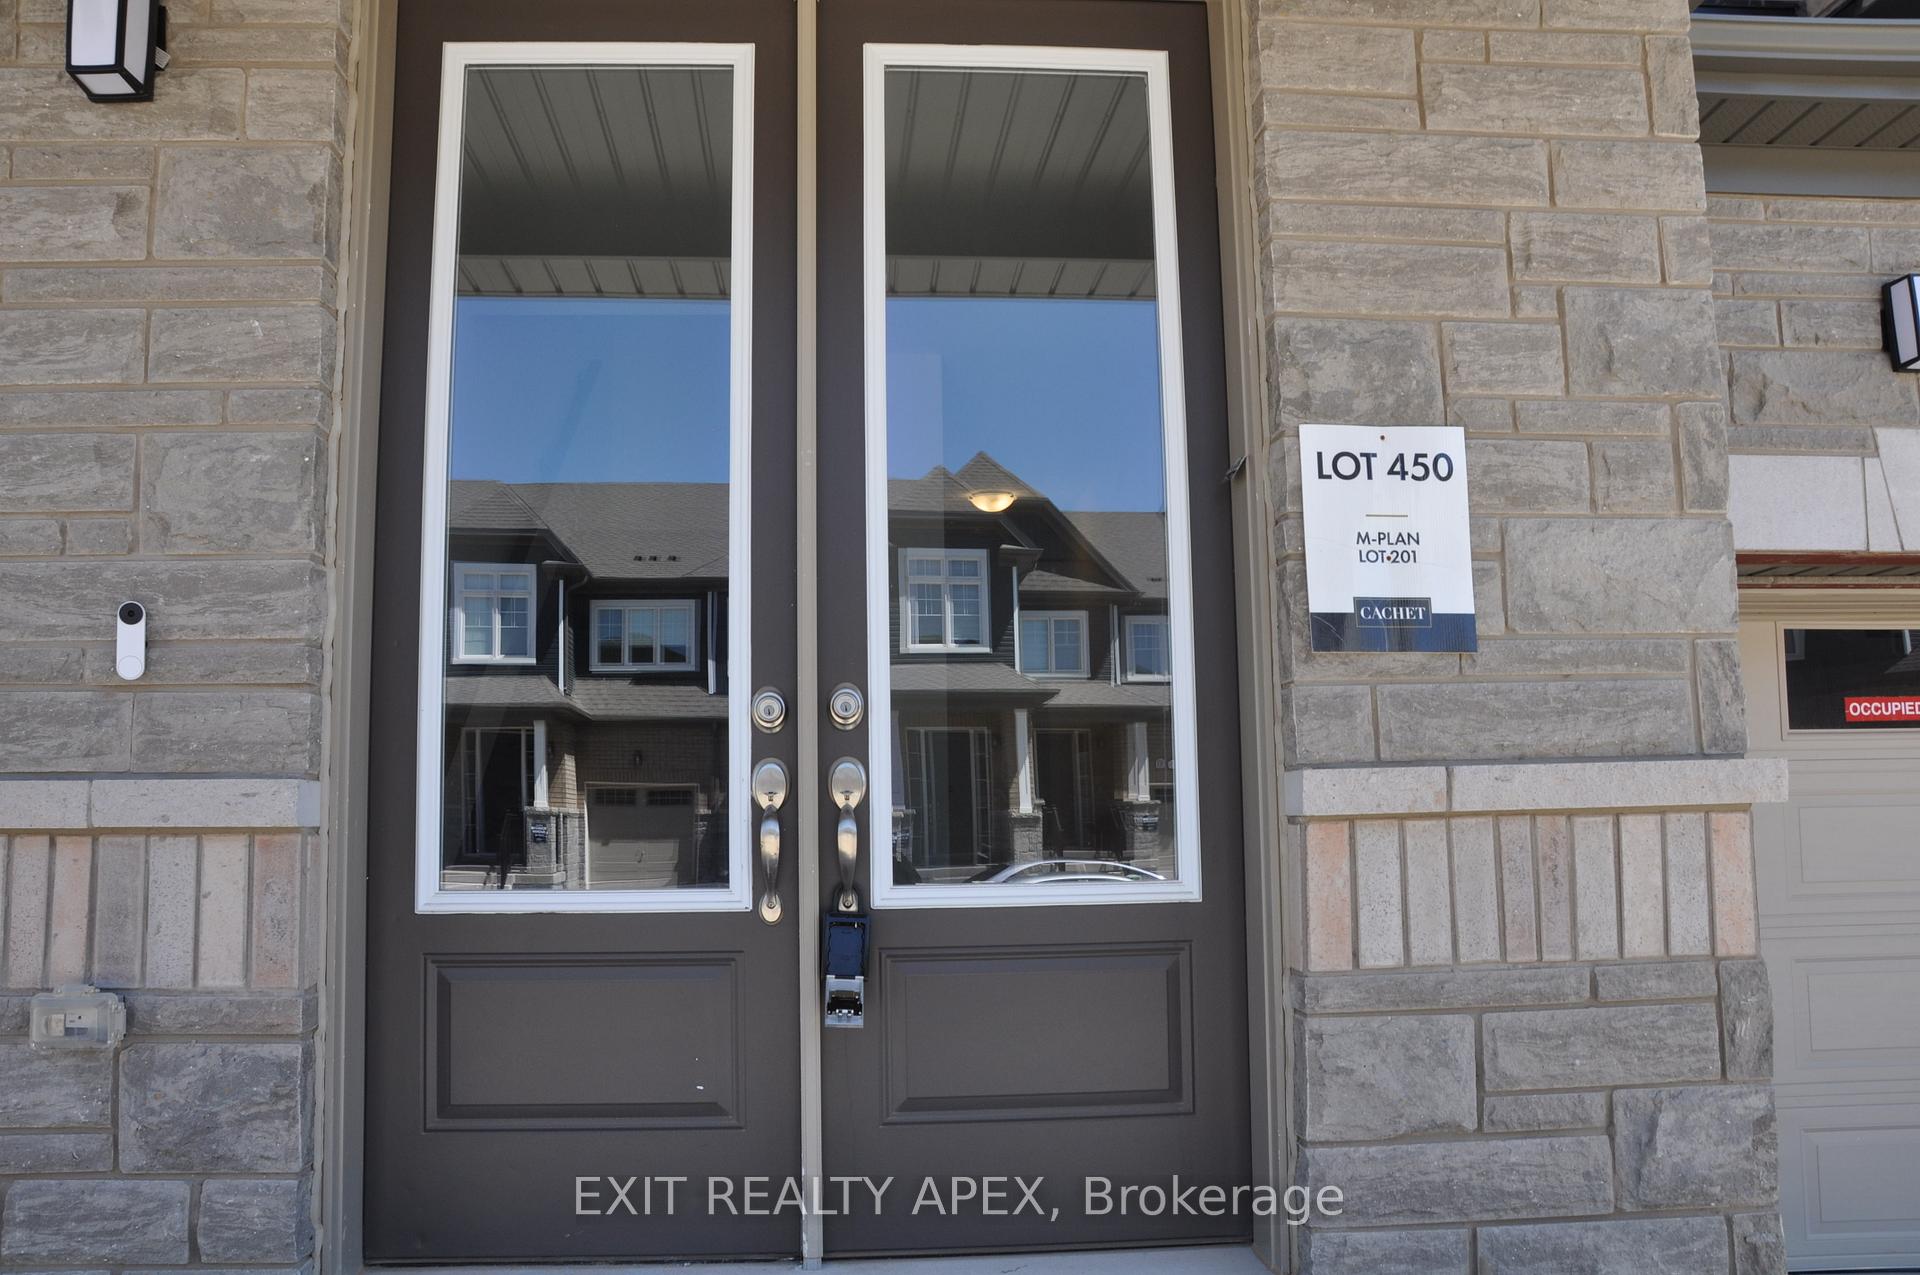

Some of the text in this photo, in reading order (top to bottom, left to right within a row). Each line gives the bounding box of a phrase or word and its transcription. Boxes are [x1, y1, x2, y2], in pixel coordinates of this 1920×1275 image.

[1316, 451, 1454, 482] LOT 450
[1356, 531, 1420, 546] M-PLAN
[1359, 549, 1417, 564] LOT 201
[1360, 606, 1426, 620] CACHET
